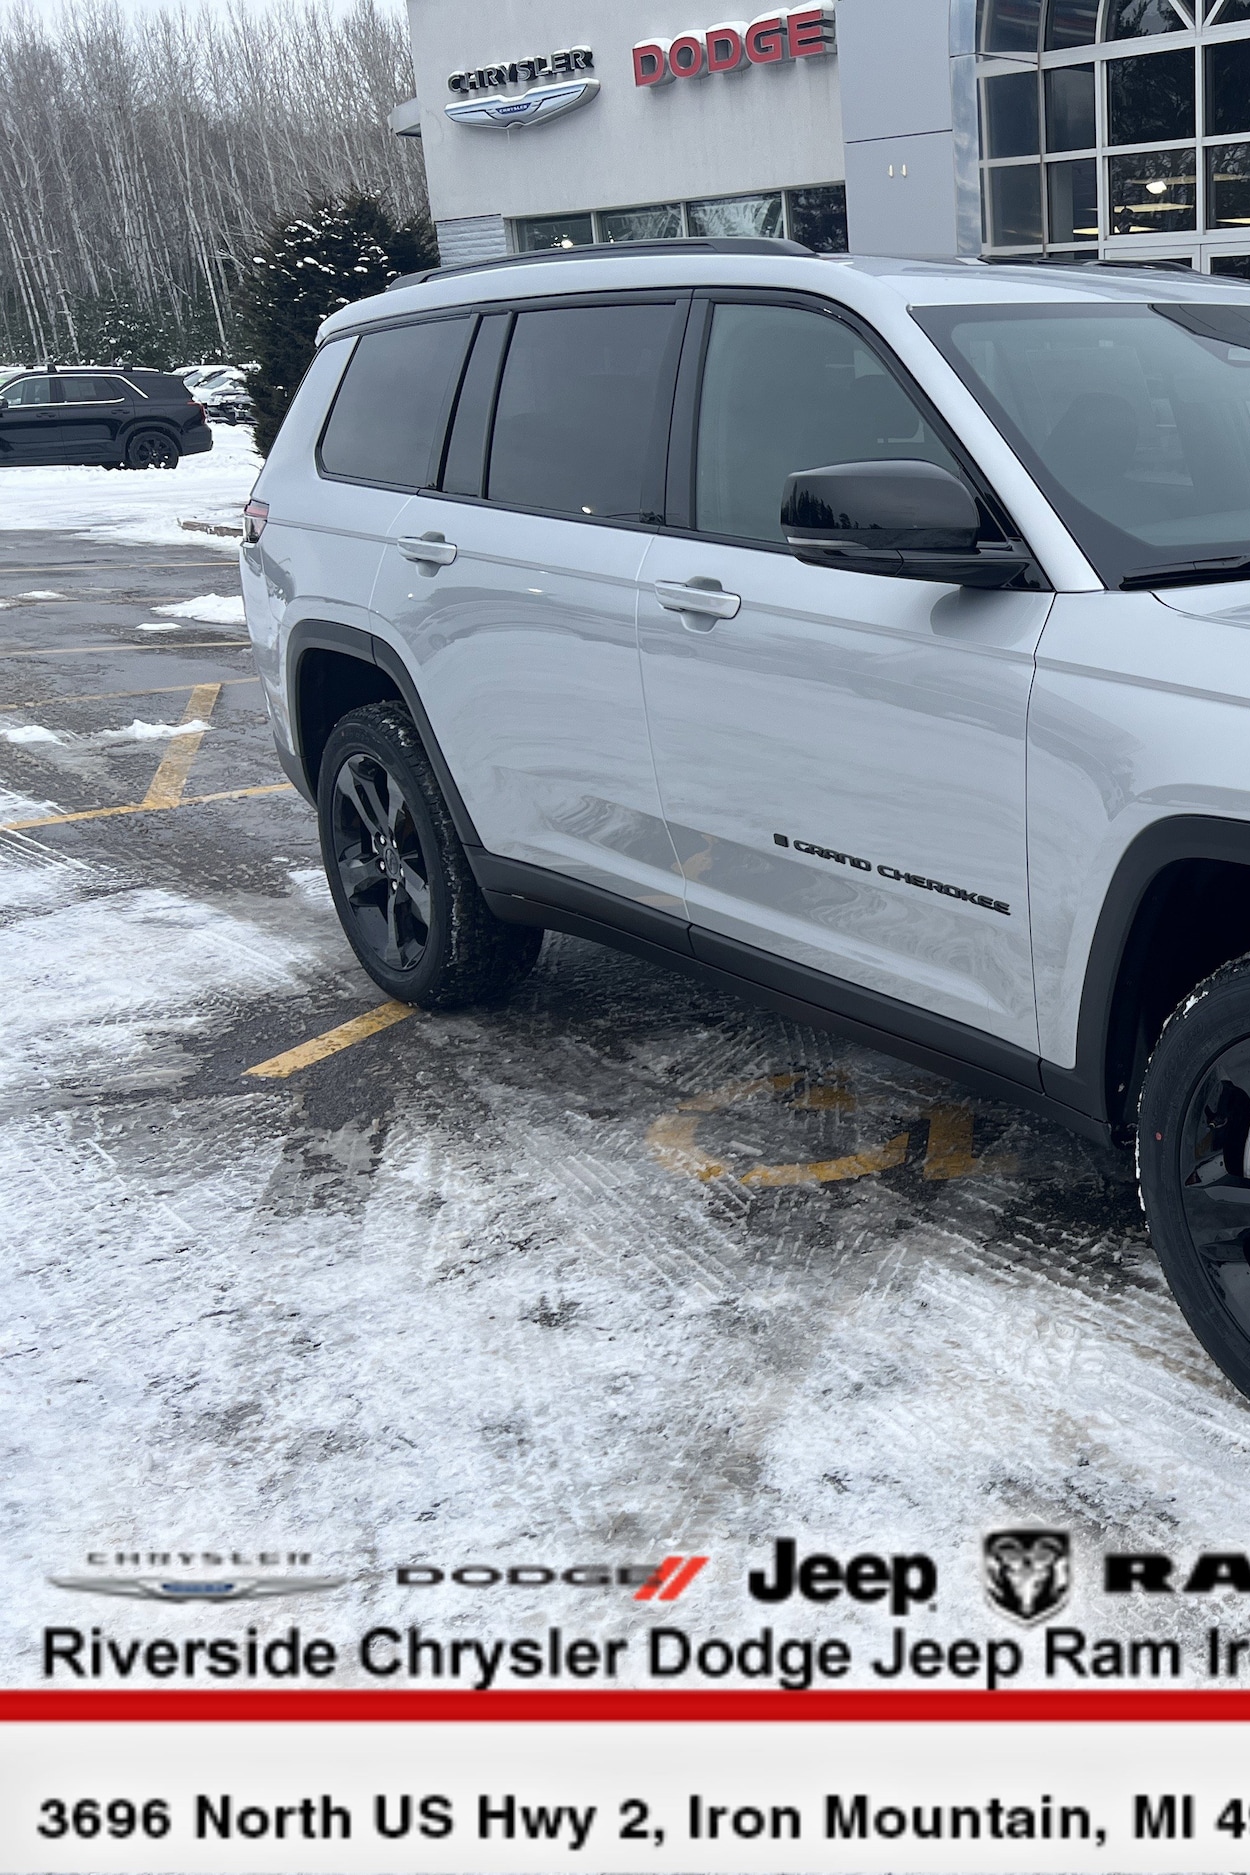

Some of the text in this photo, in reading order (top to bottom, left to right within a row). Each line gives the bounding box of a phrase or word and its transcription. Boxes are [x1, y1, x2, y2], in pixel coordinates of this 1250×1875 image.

[447, 48, 594, 93] CHRYSLER
[632, 8, 829, 87] DODGE
[793, 839, 1011, 916] GRAND CHEROKEE
